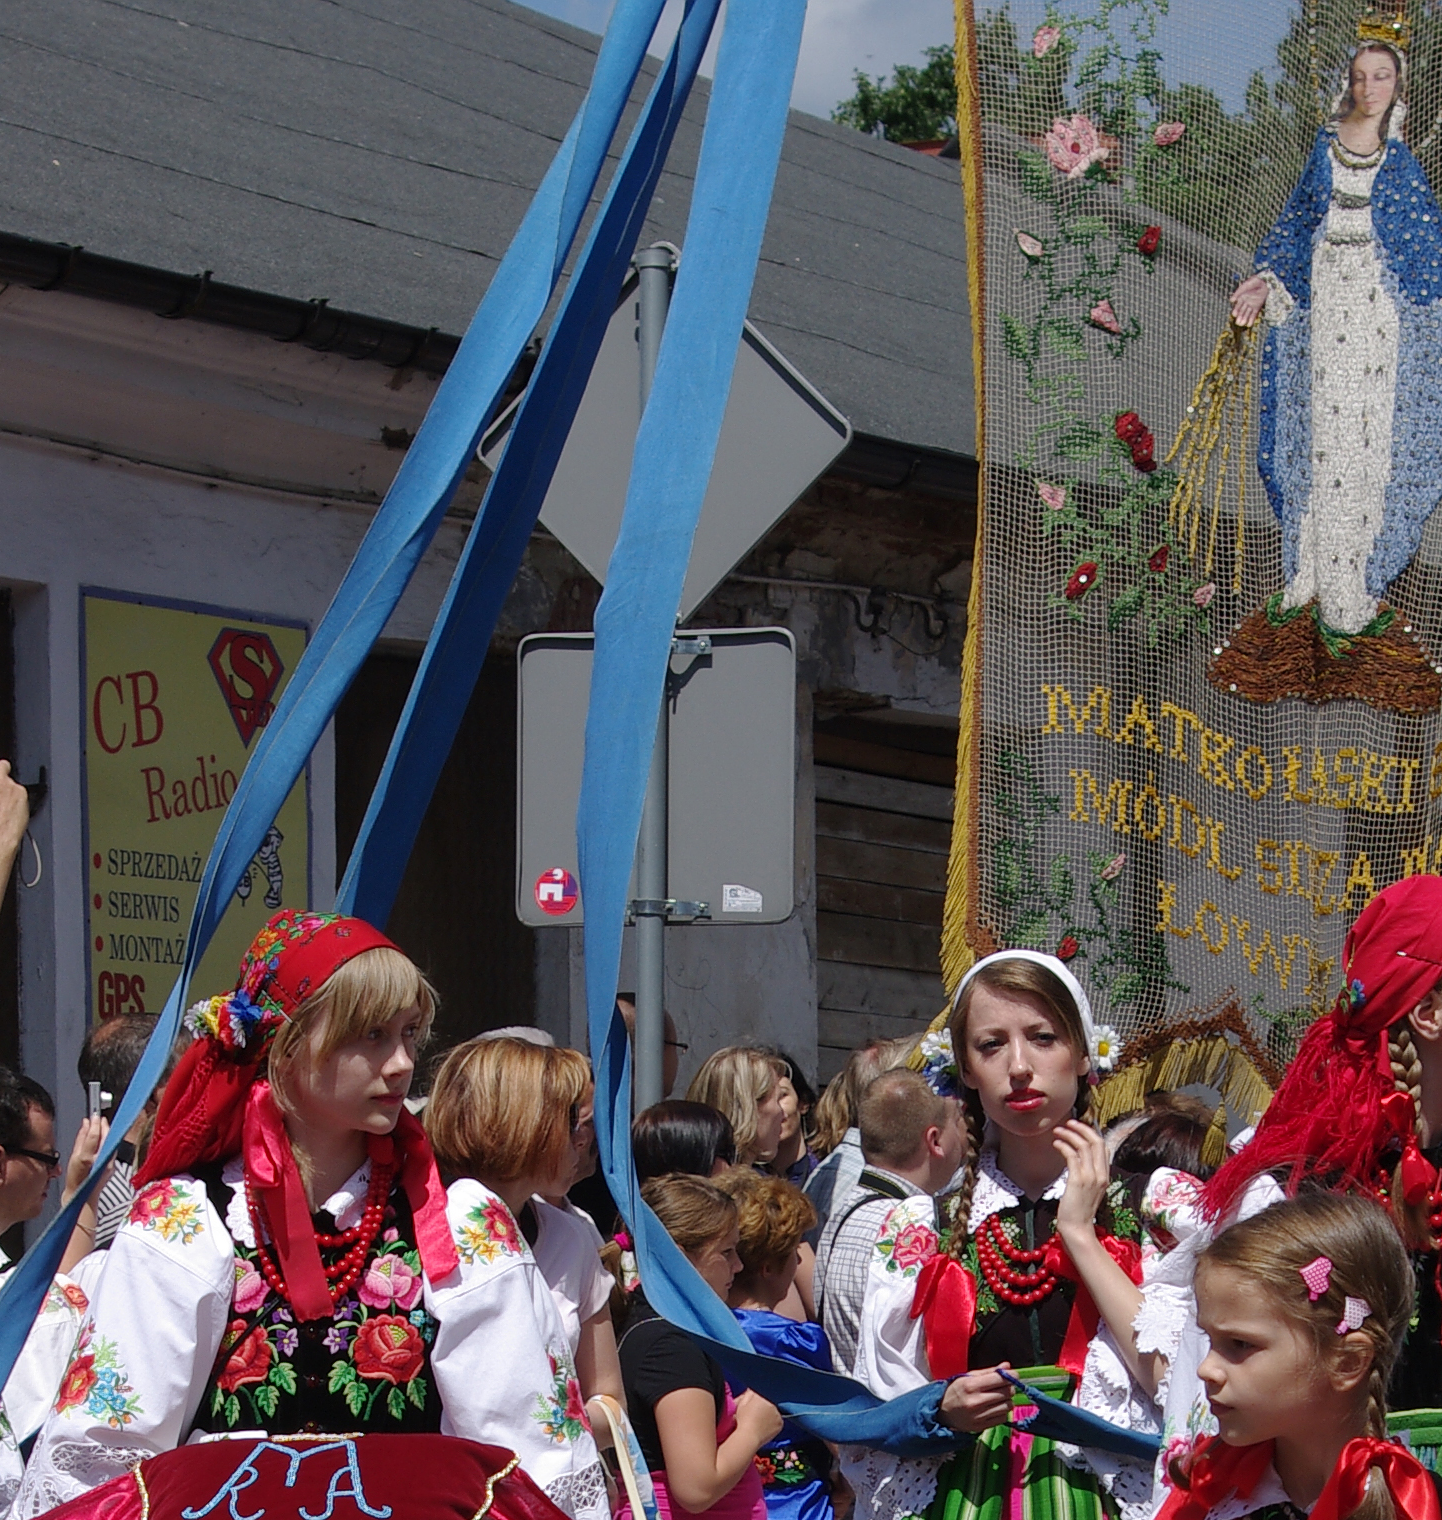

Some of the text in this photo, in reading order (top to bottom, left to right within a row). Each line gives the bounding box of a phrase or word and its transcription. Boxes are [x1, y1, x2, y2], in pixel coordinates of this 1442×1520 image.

[93, 670, 164, 754] CB
[1042, 683, 1272, 800] MATKO
[141, 754, 239, 824] Radio
[1068, 767, 1243, 882] MÓDL
[108, 848, 203, 884] SPRZEDAŻ
[108, 890, 180, 924] SERWIS
[109, 932, 186, 966] MONTAŻ
[98, 970, 146, 1022] GPS
